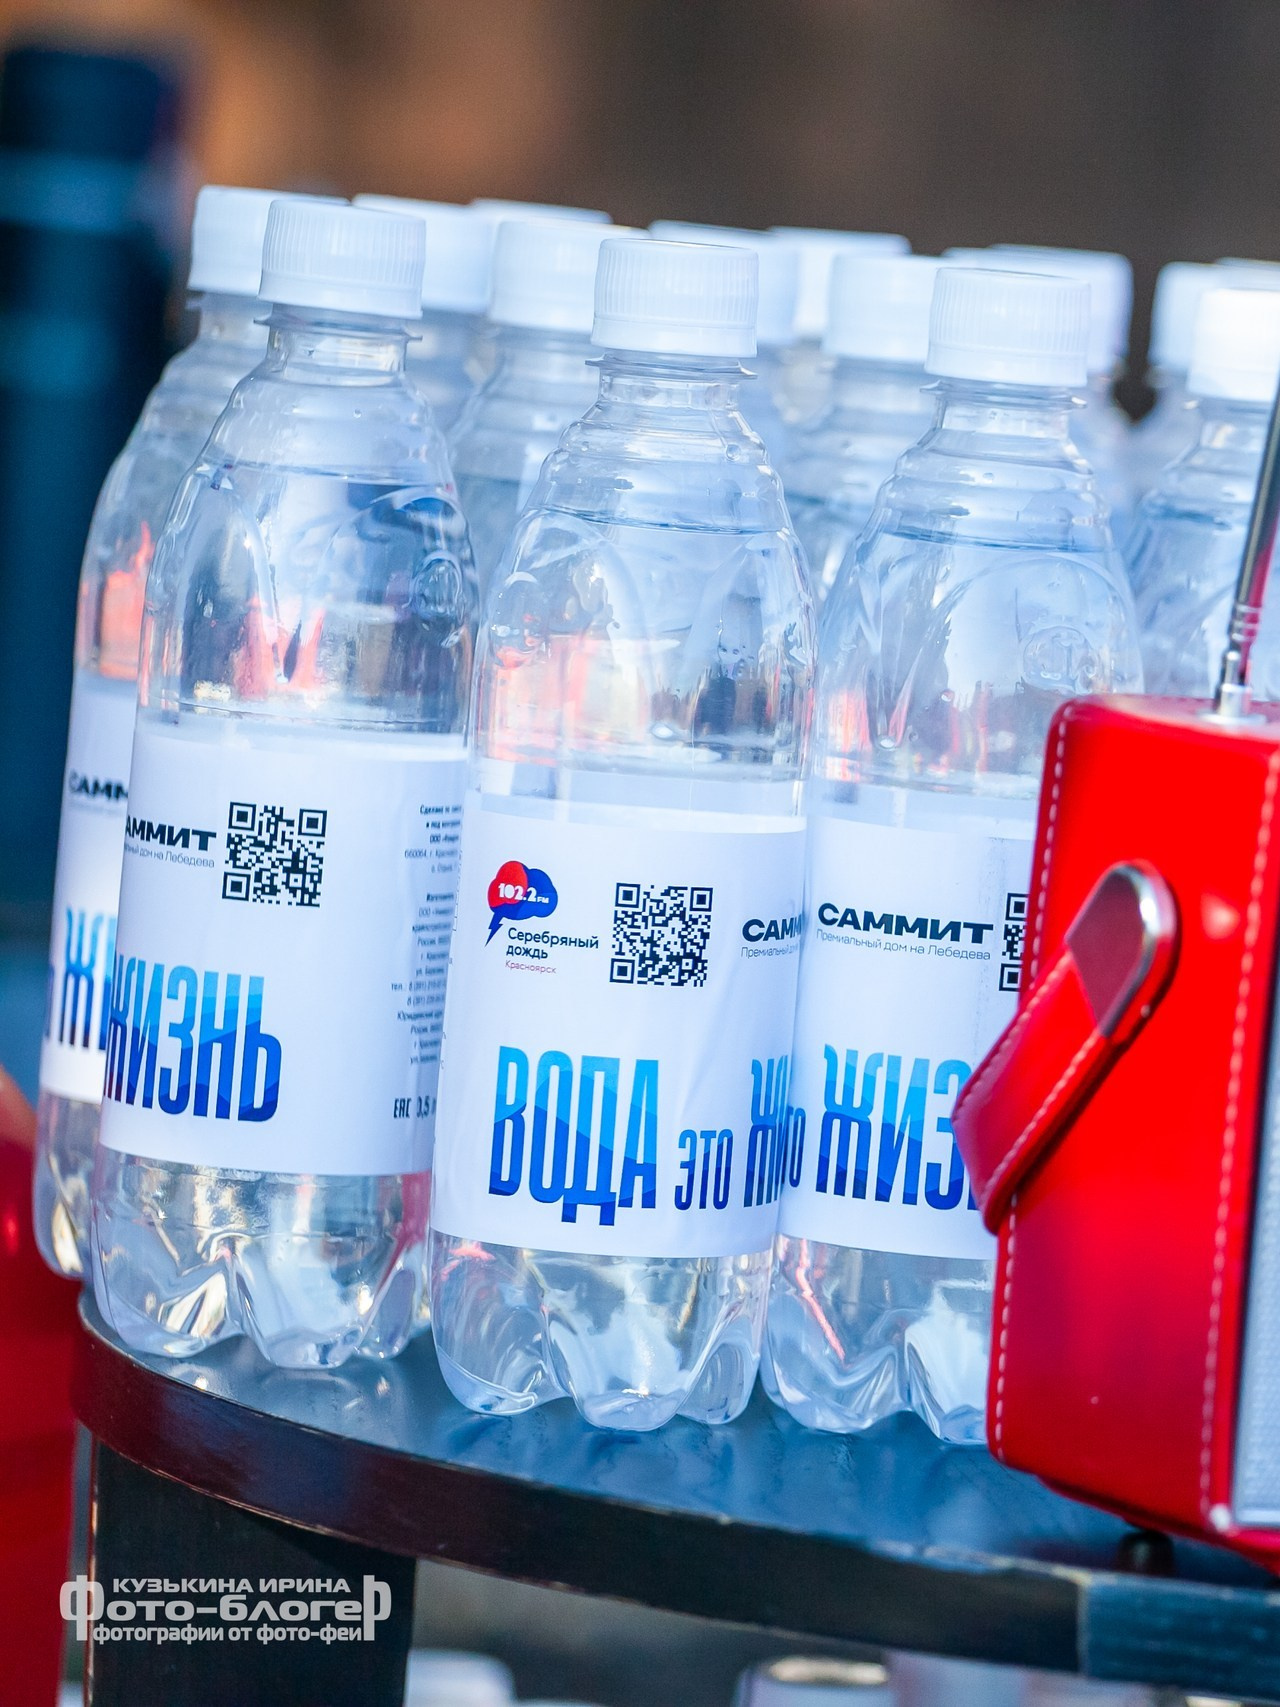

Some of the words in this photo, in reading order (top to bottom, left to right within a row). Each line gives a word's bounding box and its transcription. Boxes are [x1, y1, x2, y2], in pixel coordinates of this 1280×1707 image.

[165, 851, 215, 868] Лебедева
[498, 883, 537, 902] 102.2
[818, 902, 994, 944] САММИТ
[508, 927, 599, 949] Серебряный
[816, 929, 882, 949] Премиальный
[884, 942, 908, 953] дом
[910, 943, 925, 955] на
[928, 945, 991, 961] Лебедева
[506, 945, 549, 960] дождь
[505, 960, 557, 974] Красноярск
[103, 951, 282, 1122] ЖИЗНЬ
[489, 1045, 659, 1226] ВОДА
[815, 1043, 981, 1212] ЖИЗ
